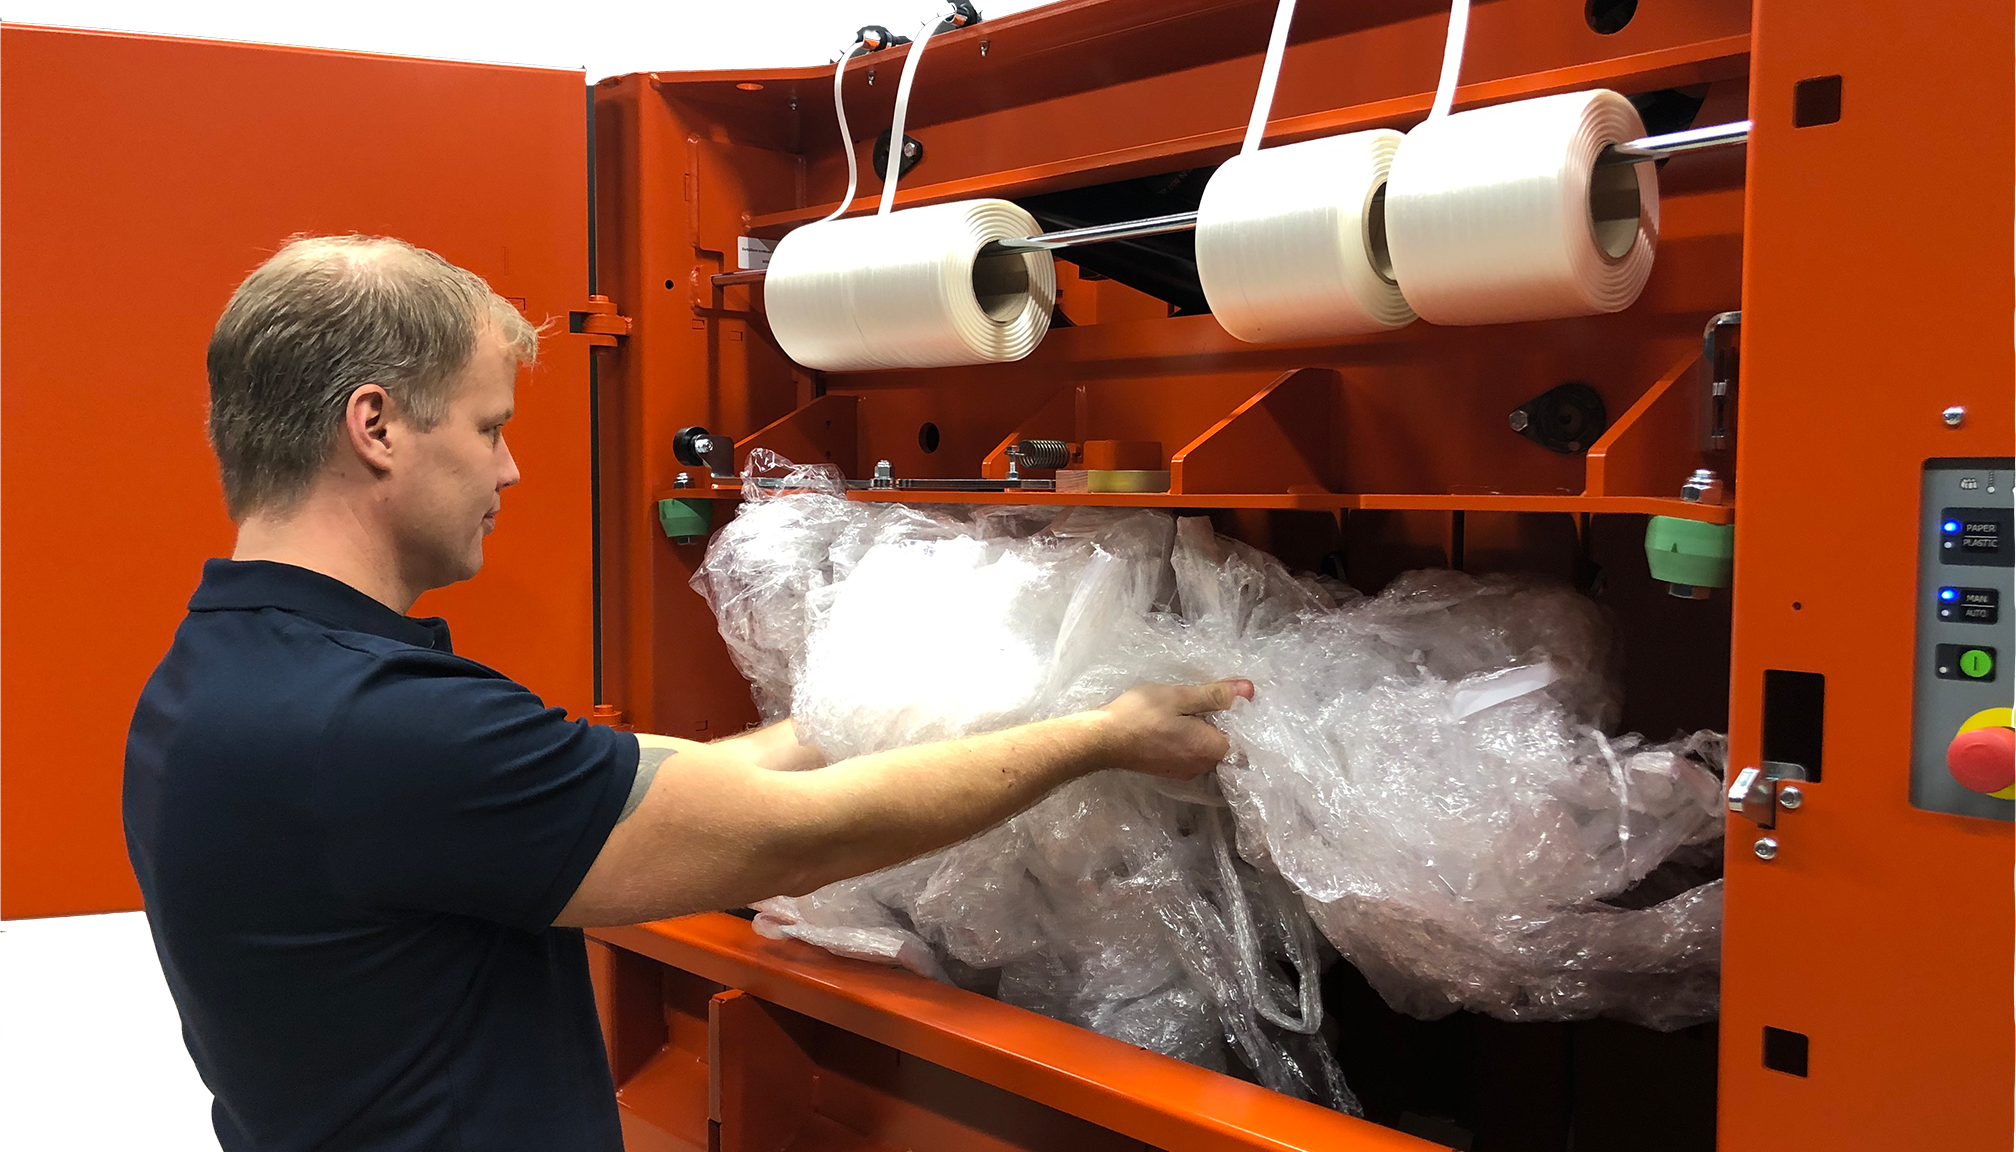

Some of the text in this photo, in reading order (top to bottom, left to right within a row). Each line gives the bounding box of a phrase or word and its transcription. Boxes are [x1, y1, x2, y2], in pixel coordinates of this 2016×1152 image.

[1966, 523, 1996, 533] PAPER
[1963, 538, 1998, 548] PLASTIC
[1965, 609, 1987, 618] AUTO
